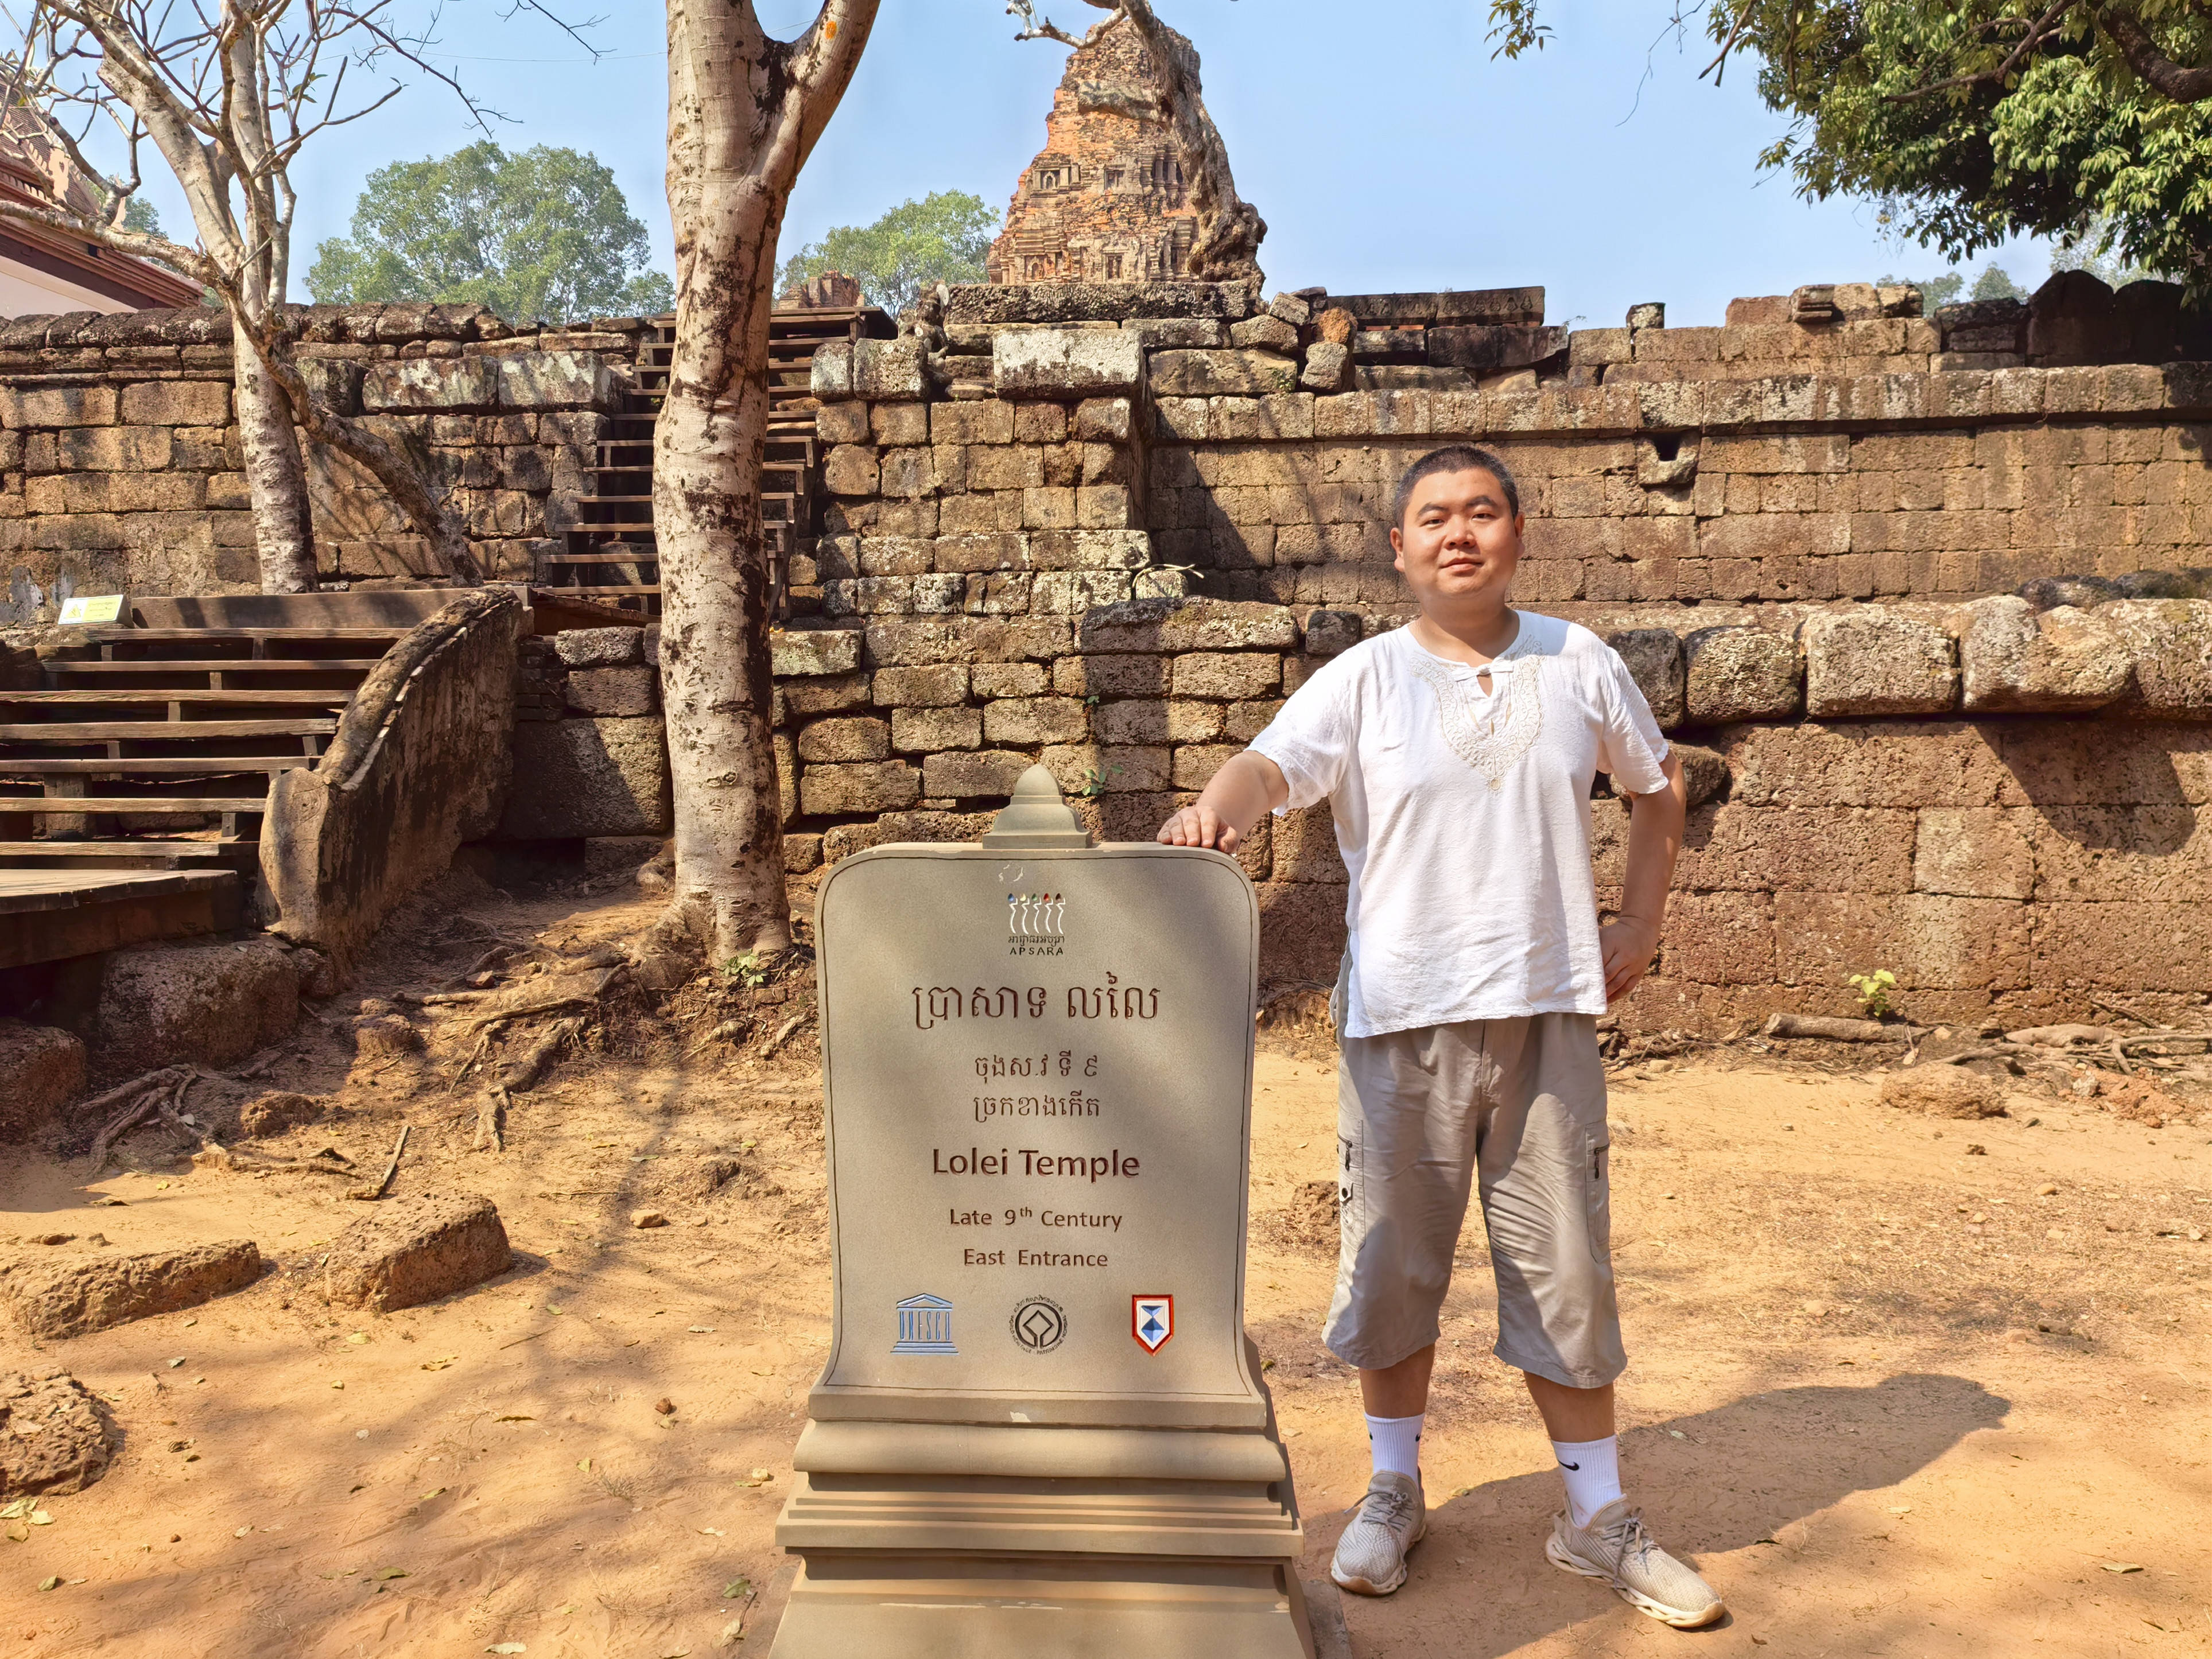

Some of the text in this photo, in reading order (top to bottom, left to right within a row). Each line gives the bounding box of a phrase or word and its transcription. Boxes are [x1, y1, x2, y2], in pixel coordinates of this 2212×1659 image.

[1010, 946, 1064, 955] APSARA
[911, 971, 1161, 1030] ប្រាសាទ លលៃ
[1059, 1050, 1072, 1077] ទី
[1084, 1055, 1098, 1077] ៩
[973, 1090, 1101, 1123] ច្រកខាងកើត
[933, 1147, 1140, 1184] Lolei Temple
[950, 1206, 1123, 1233] Late 9th Century
[964, 1249, 1109, 1267] East Entrance
[899, 1311, 950, 1341] UNESCO
